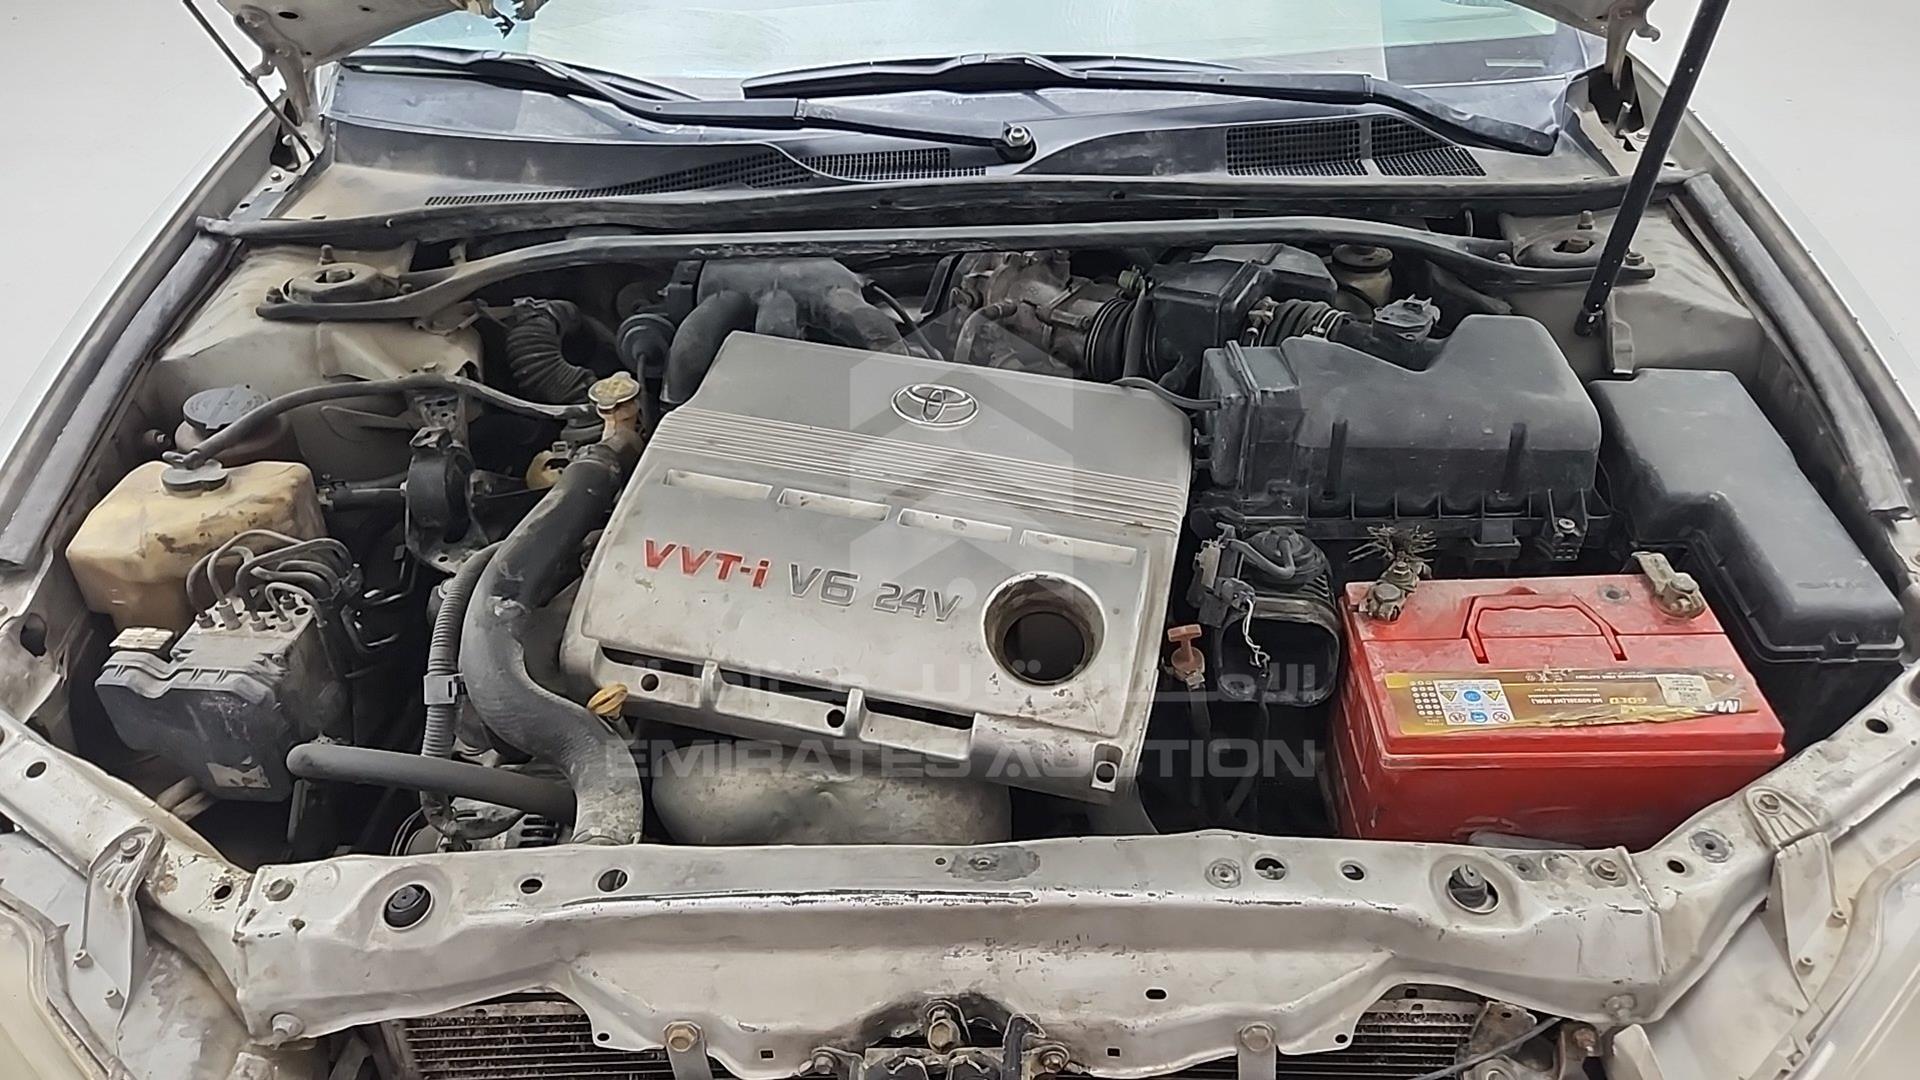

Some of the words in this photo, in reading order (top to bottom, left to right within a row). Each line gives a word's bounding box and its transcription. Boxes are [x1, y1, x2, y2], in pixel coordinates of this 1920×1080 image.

[644, 538, 771, 589] VVT-i
[788, 562, 862, 607] V6
[872, 582, 965, 623] 24V
